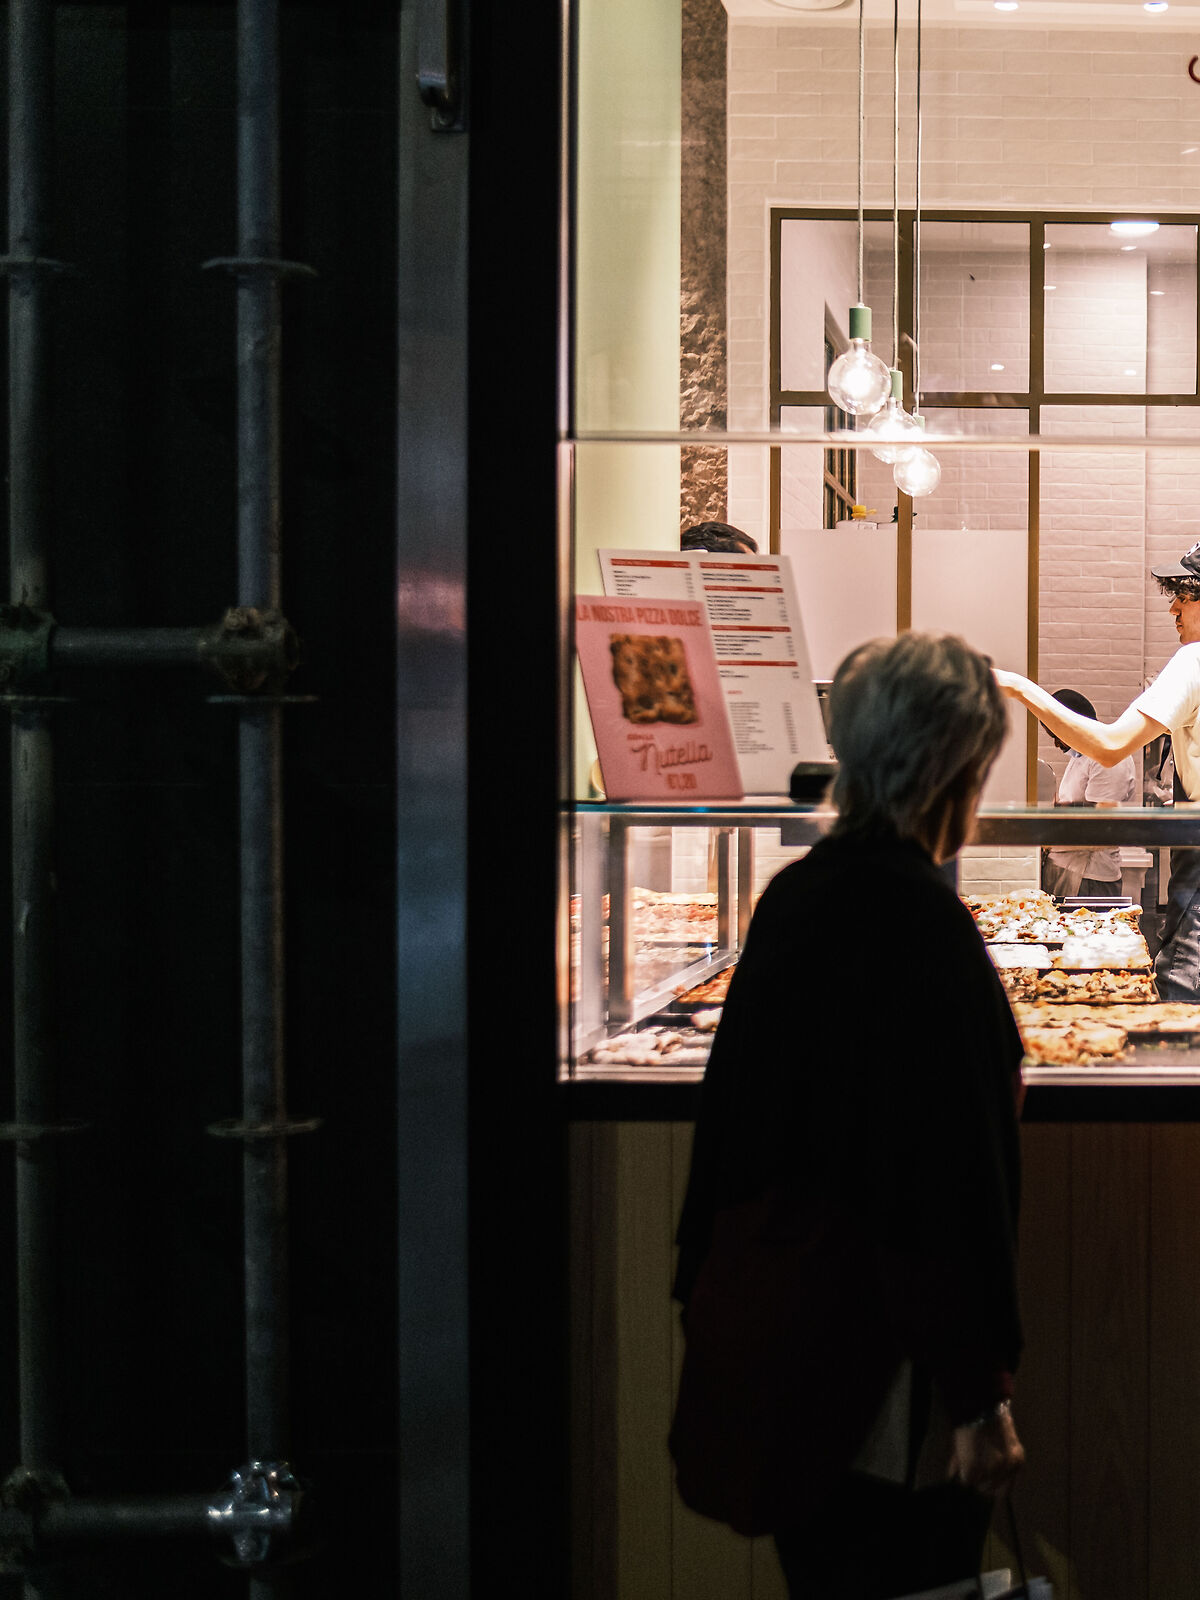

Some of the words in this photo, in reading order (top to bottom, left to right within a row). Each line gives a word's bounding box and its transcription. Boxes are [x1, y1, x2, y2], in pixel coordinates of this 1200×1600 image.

[590, 605, 636, 623] NOSTRA
[636, 606, 669, 625] PIZZA
[668, 608, 703, 627] DOLCE
